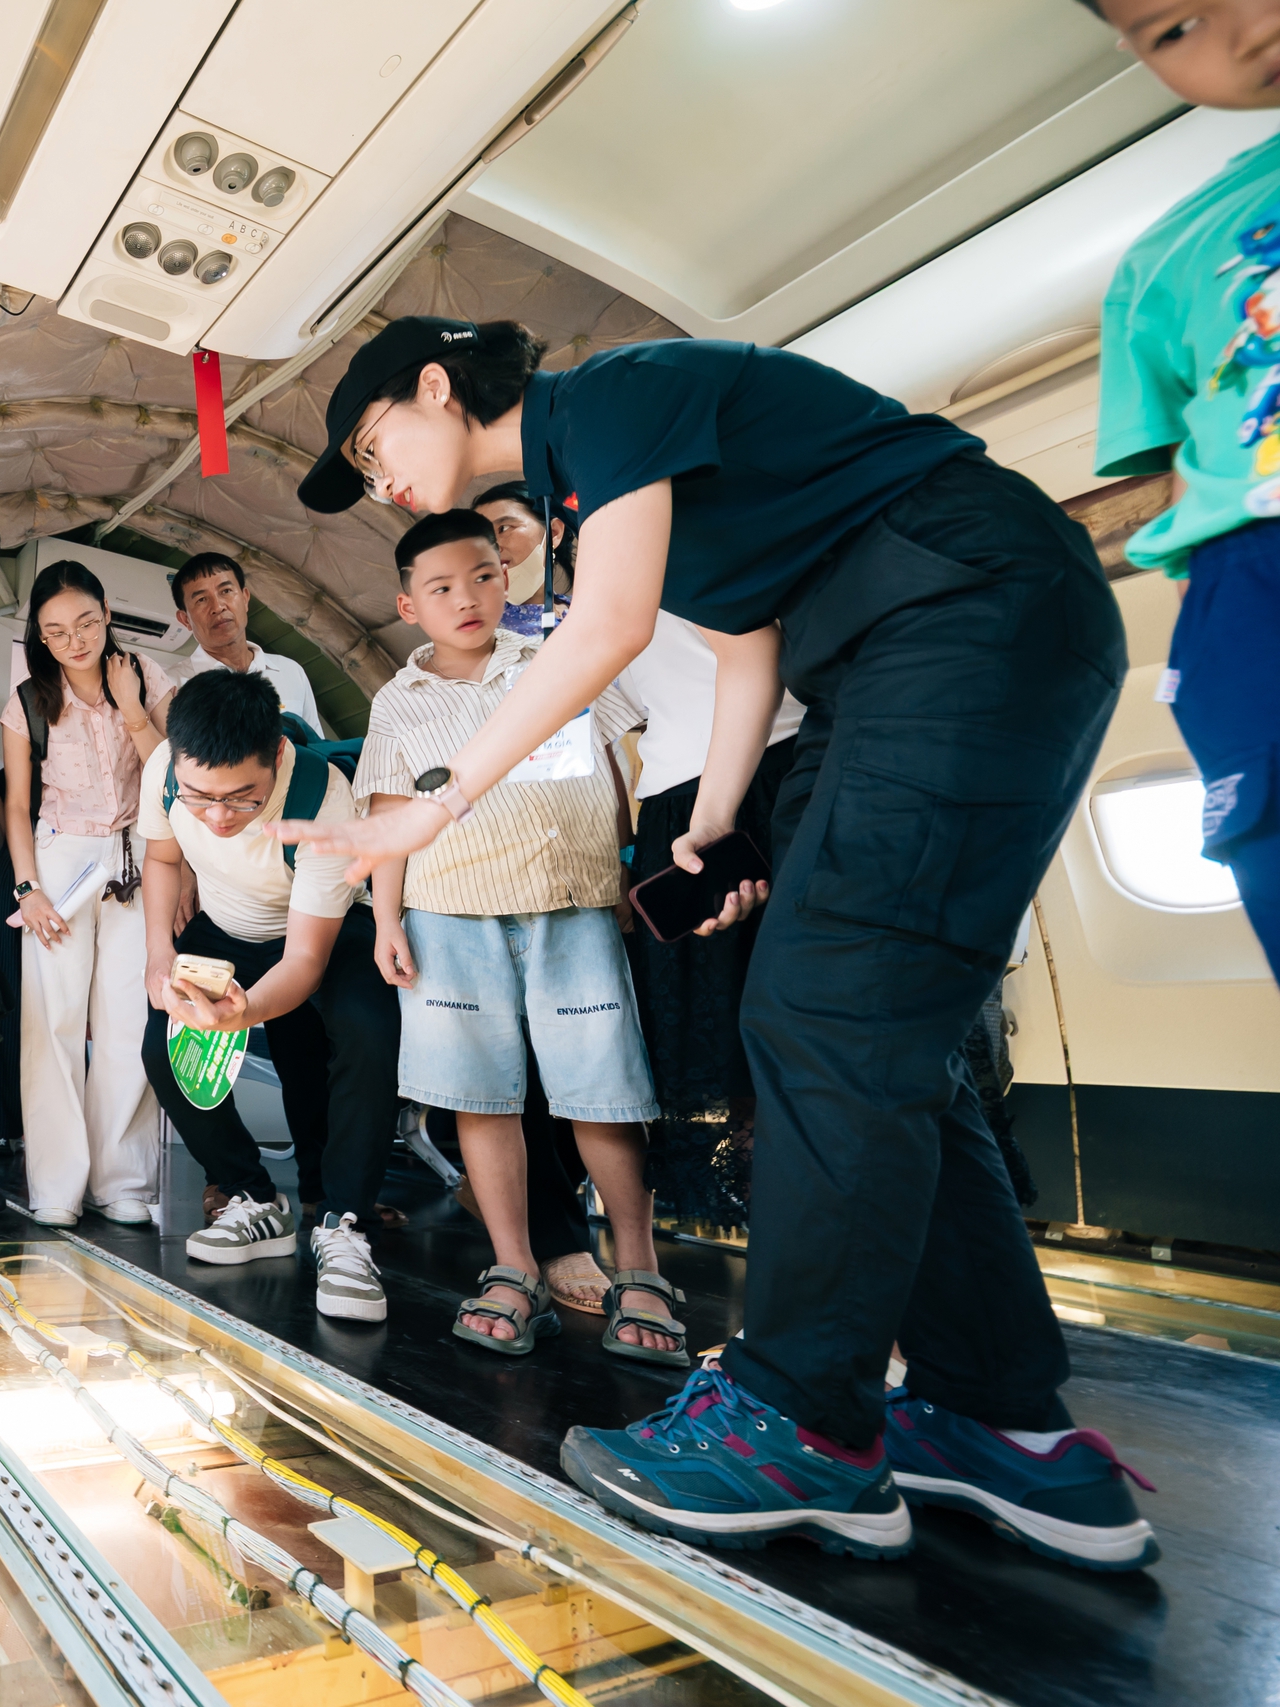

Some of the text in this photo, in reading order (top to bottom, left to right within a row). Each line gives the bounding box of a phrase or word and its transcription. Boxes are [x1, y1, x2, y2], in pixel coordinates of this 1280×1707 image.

[228, 220, 258, 238] A B C
[426, 999, 480, 1012] ENYAMAN KIDS
[556, 1002, 621, 1016] ENYAMAN KIDS
